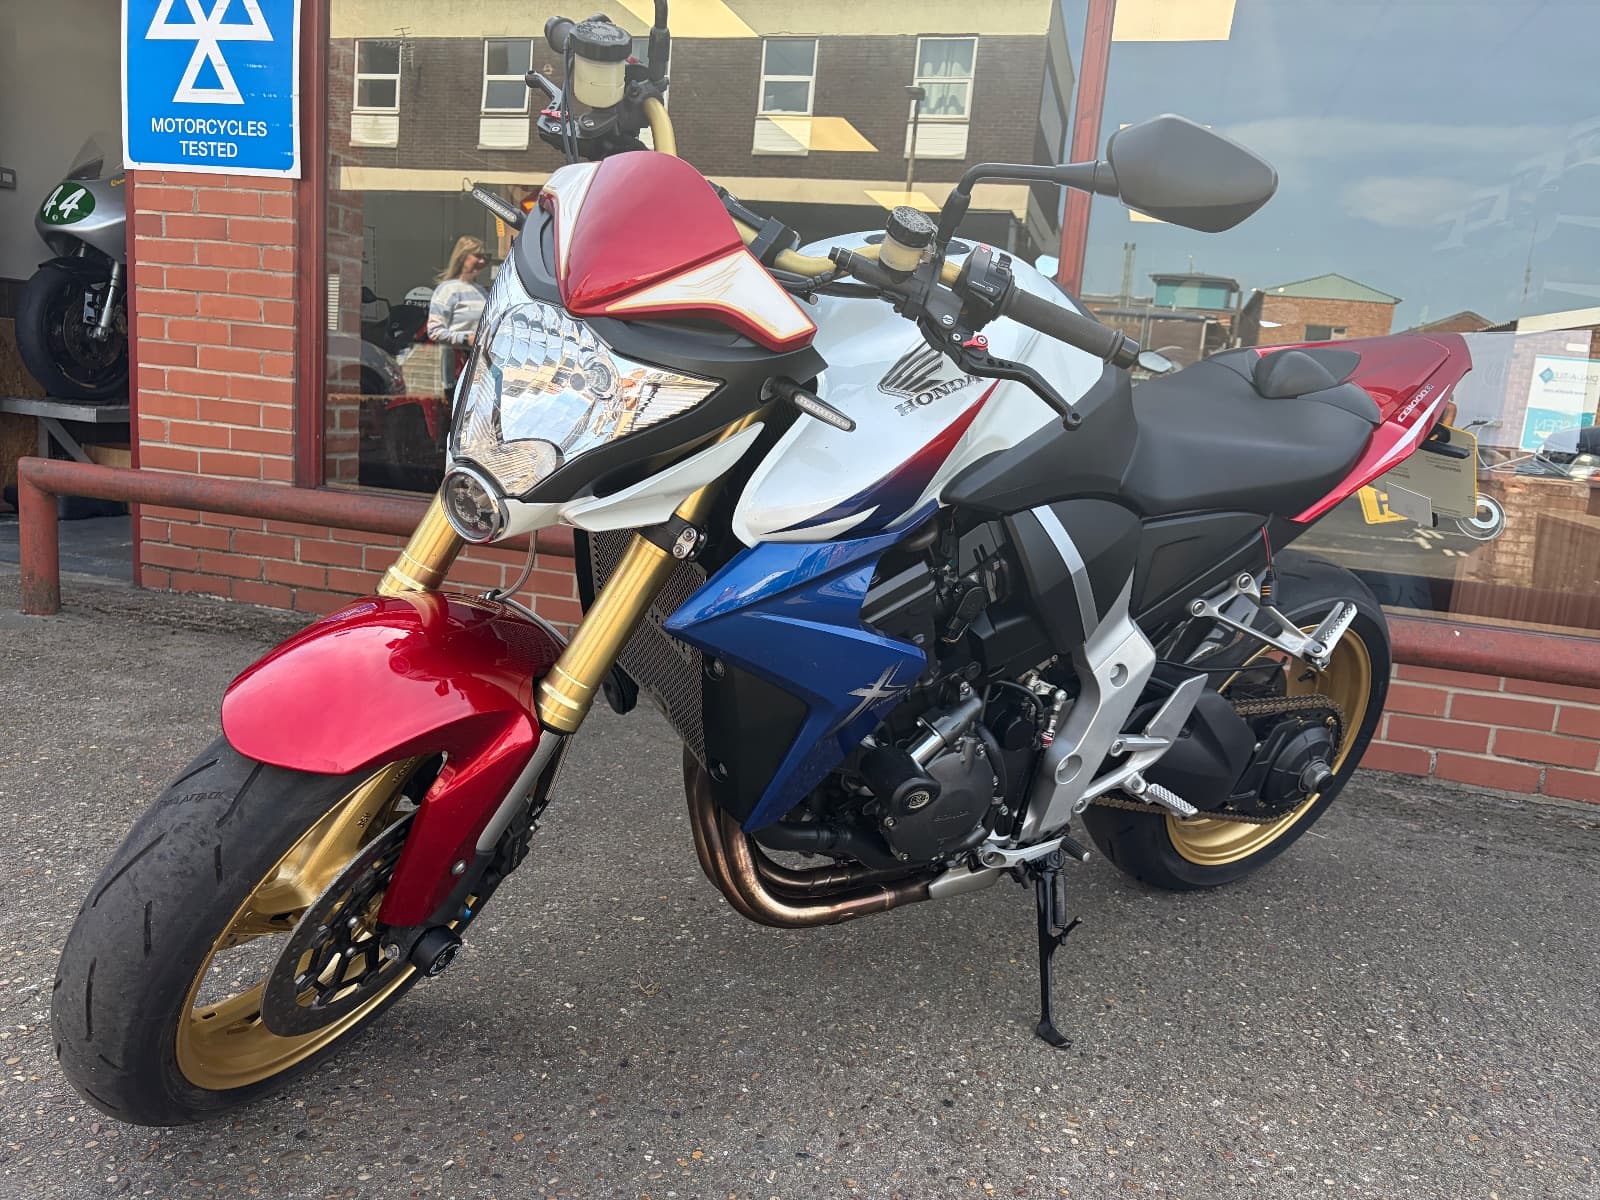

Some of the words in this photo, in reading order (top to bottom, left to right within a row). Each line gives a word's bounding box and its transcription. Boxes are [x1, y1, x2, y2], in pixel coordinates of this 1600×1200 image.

[151, 117, 268, 137] MOTORCYCLES
[179, 140, 238, 158] TESTED
[893, 374, 984, 417] HONDA
